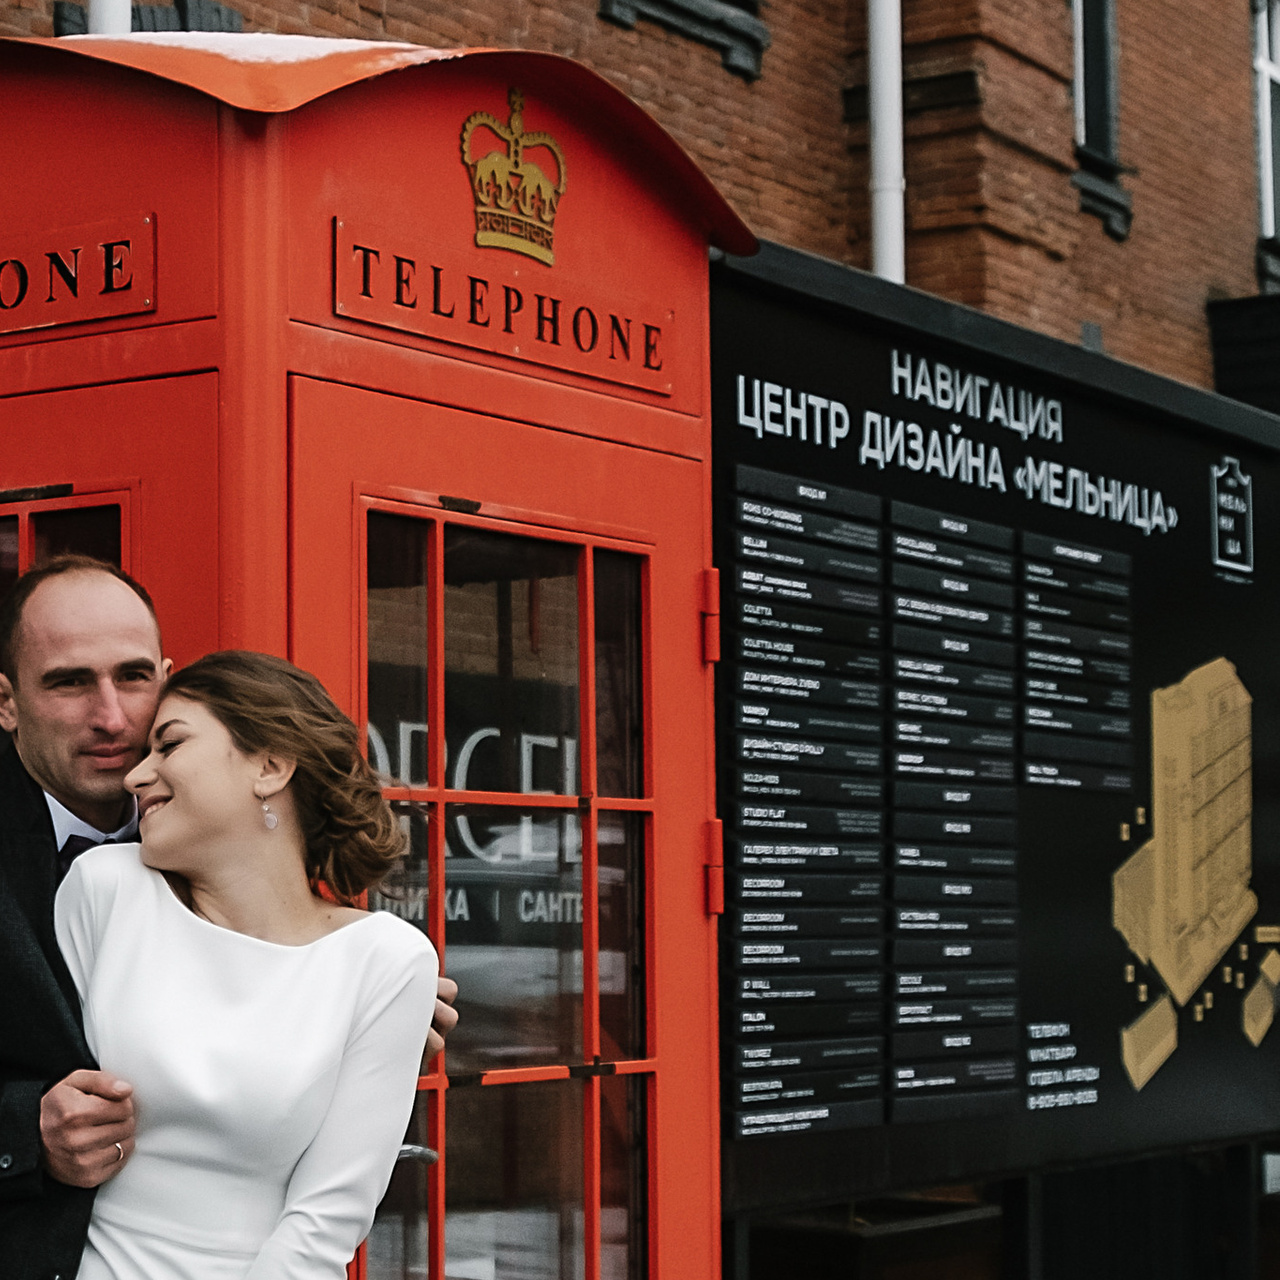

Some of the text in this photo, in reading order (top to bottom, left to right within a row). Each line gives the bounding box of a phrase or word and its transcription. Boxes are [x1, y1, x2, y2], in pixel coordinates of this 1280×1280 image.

[353, 244, 663, 372] TELEPHONE
[736, 375, 1179, 535] ЦЕНТР ДИЗАЙНА «МЕЛЬНИЦА»
[891, 349, 1063, 442] НАВИГАЦИЯ
